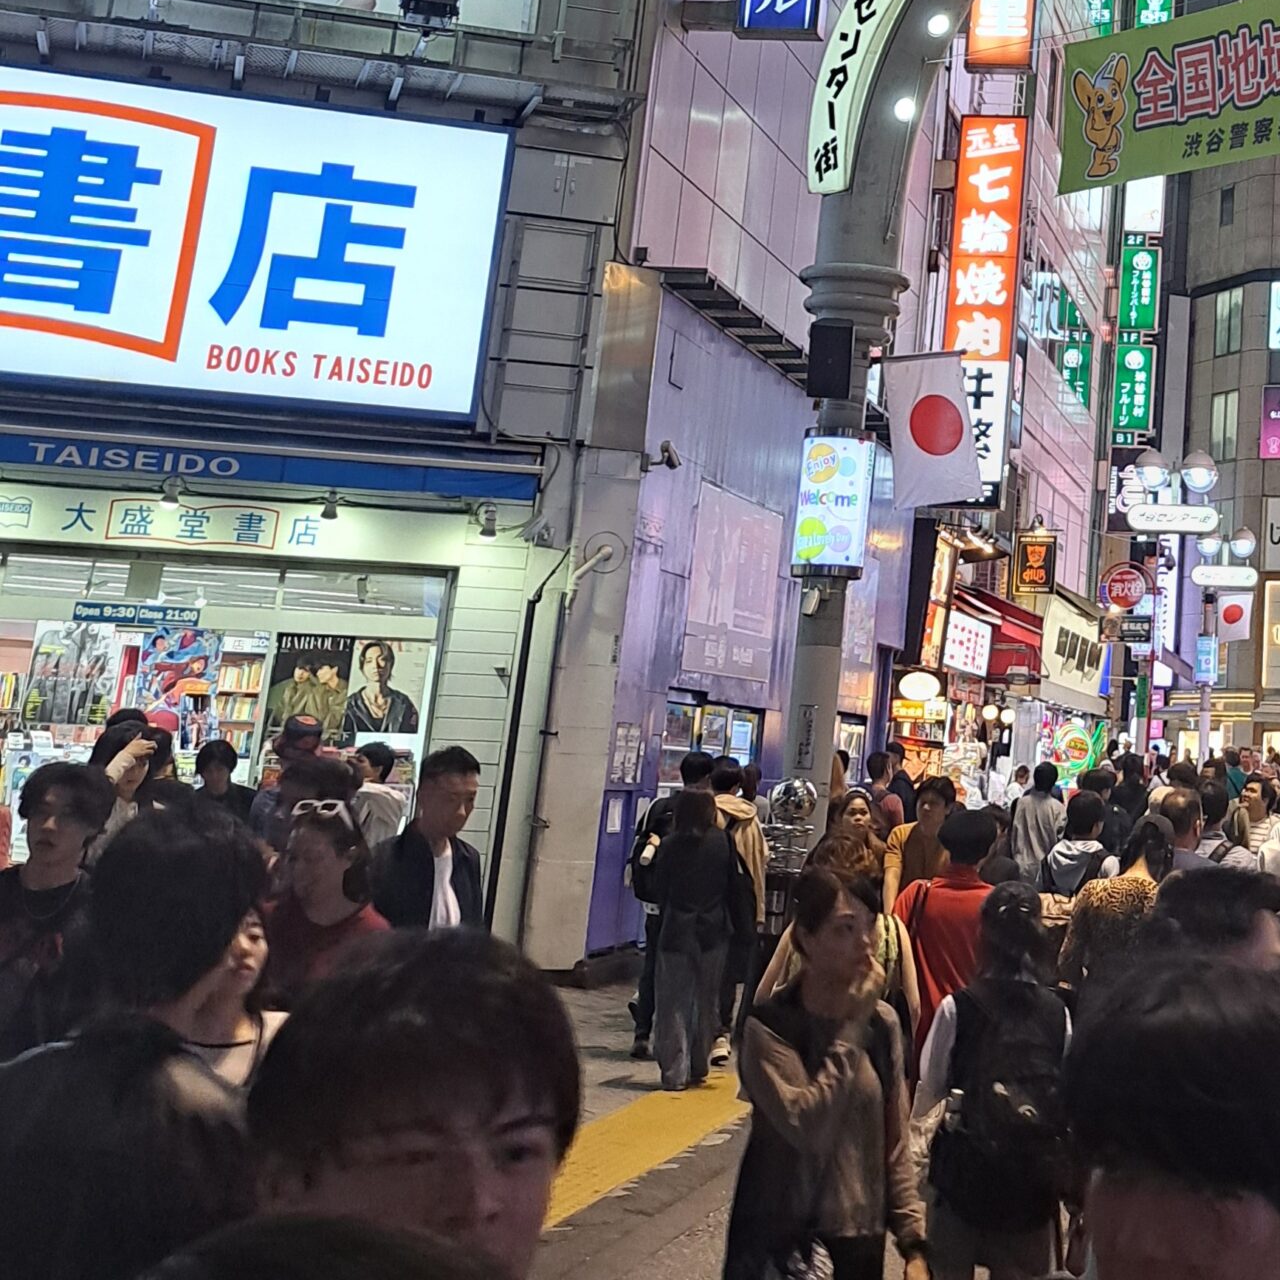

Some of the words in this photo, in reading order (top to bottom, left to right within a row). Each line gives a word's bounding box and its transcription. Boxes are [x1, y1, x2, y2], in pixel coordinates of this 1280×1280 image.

[1127, 235, 1144, 245] 2F
[954, 162, 1013, 357] 七輪焼肉
[1122, 333, 1138, 342] 1F
[206, 344, 299, 378] BOOKS
[312, 353, 434, 390] TAISEIDO
[1119, 382, 1131, 426] フルーツ
[1115, 433, 1133, 444] B1
[28, 441, 241, 477] TAISEIDO
[806, 453, 837, 477] Enjoy
[800, 488, 858, 507] Welcome
[61, 501, 321, 547] 大盛堂書店
[1110, 581, 1142, 597] 消火栓
[75, 604, 101, 618] Open
[103, 604, 135, 619] 9:30
[138, 608, 165, 620] Close
[165, 608, 199, 622] 21:00
[281, 635, 351, 651] BARFOUT!
